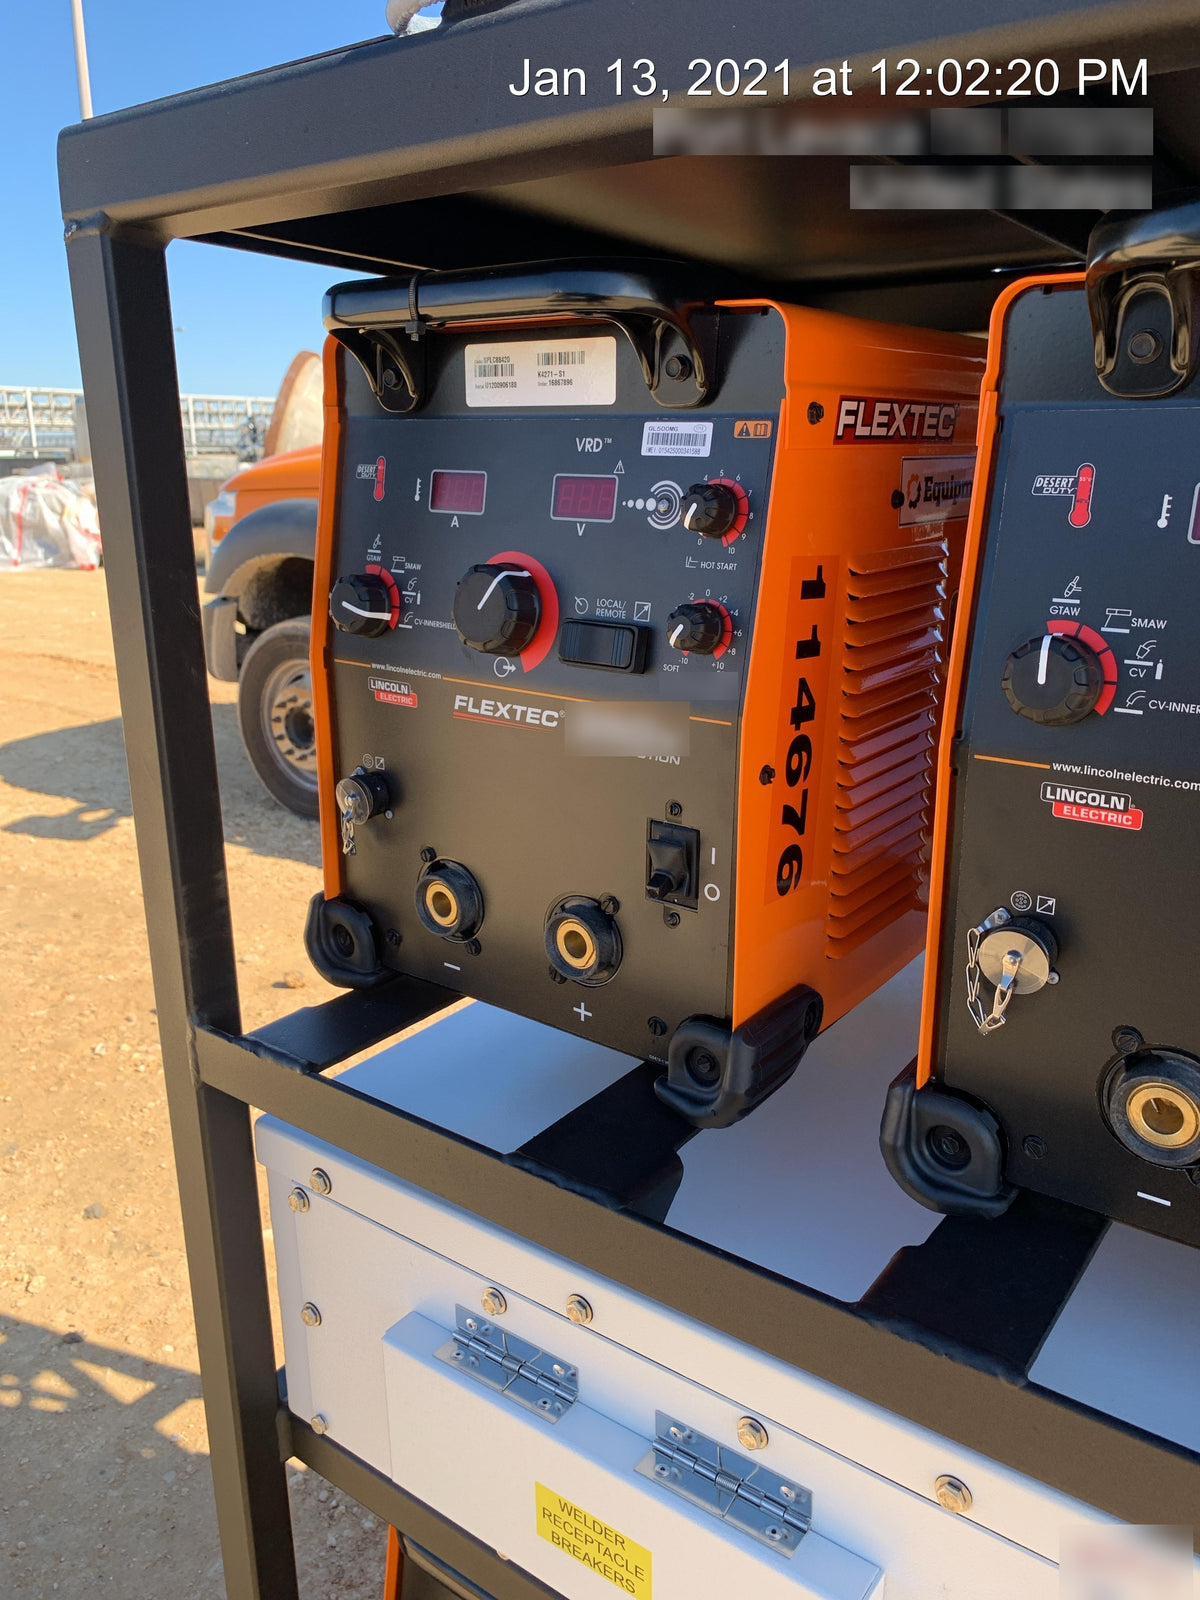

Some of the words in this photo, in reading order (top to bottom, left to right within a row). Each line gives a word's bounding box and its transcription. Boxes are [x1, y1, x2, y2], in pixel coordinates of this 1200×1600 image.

[357, 465, 376, 473] DESERT
[719, 469, 724, 477] 5
[1036, 477, 1074, 488] DESERT
[748, 489, 753, 497] 7
[450, 515, 459, 528] A
[576, 523, 586, 537] V
[741, 533, 747, 541] 9
[728, 547, 735, 555] 10
[366, 554, 382, 562] GTAW
[404, 562, 422, 571] SMAW
[700, 561, 715, 569] HOT
[716, 562, 738, 571] START
[596, 598, 627, 610] LOCAL/
[595, 608, 626, 619] REMOTE
[1049, 605, 1081, 616] GTAW
[1130, 617, 1167, 629] SMAW
[371, 662, 442, 679] www.lincolnelectric.com
[662, 663, 680, 673] SOFT
[1129, 667, 1147, 678] CV
[370, 679, 409, 694] LINCOLN
[379, 692, 413, 705] ELECTRIC
[776, 564, 826, 896] 114676
[1052, 761, 1200, 791] www.lincolnelectric.com
[1045, 786, 1125, 811] LINCOLN
[1063, 805, 1133, 825] ELECTRIC
[558, 1498, 626, 1551] WELDER
[542, 1507, 645, 1582] RECEPTACLE
[551, 1530, 636, 1594] BREAKERS
